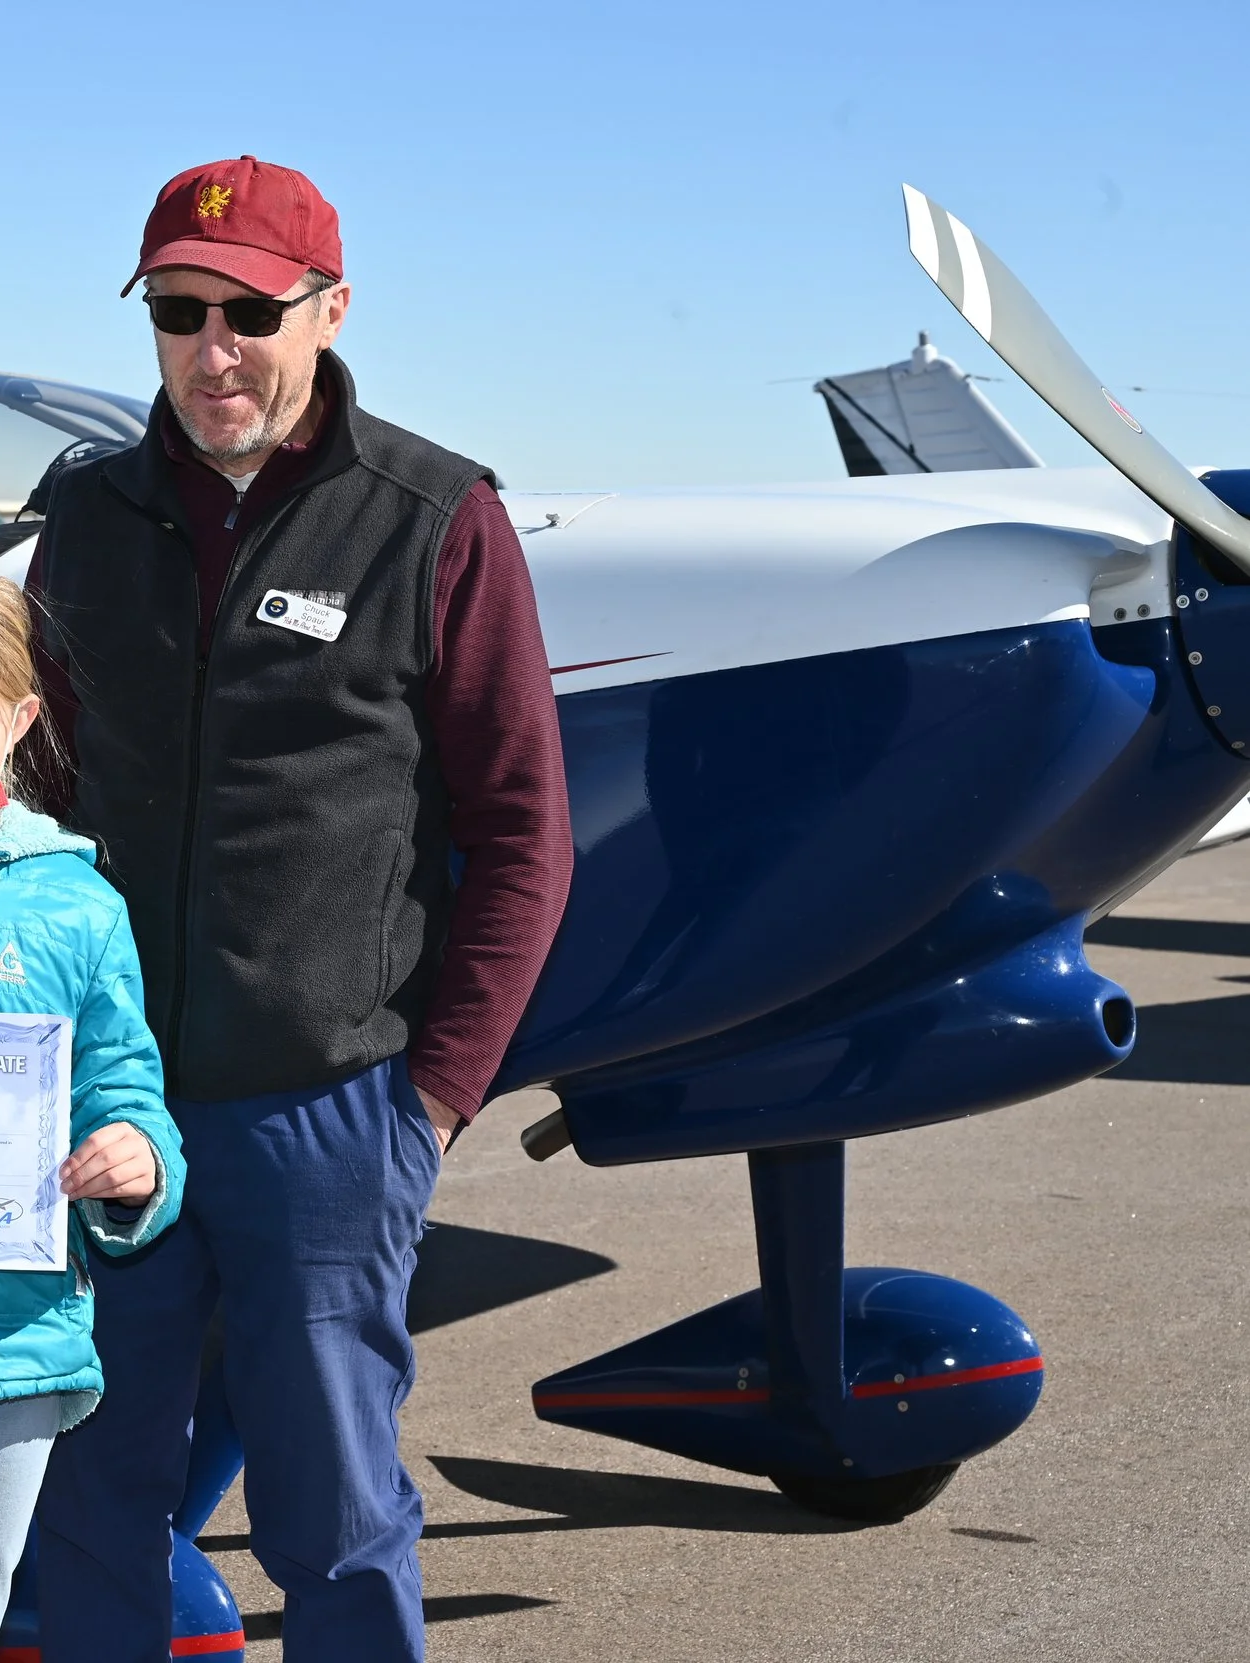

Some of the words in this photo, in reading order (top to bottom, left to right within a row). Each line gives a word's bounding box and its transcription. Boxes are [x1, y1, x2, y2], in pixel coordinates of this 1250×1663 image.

[296, 593, 340, 606] lumbia
[304, 604, 330, 617] Chuck
[301, 613, 326, 625] Spaur
